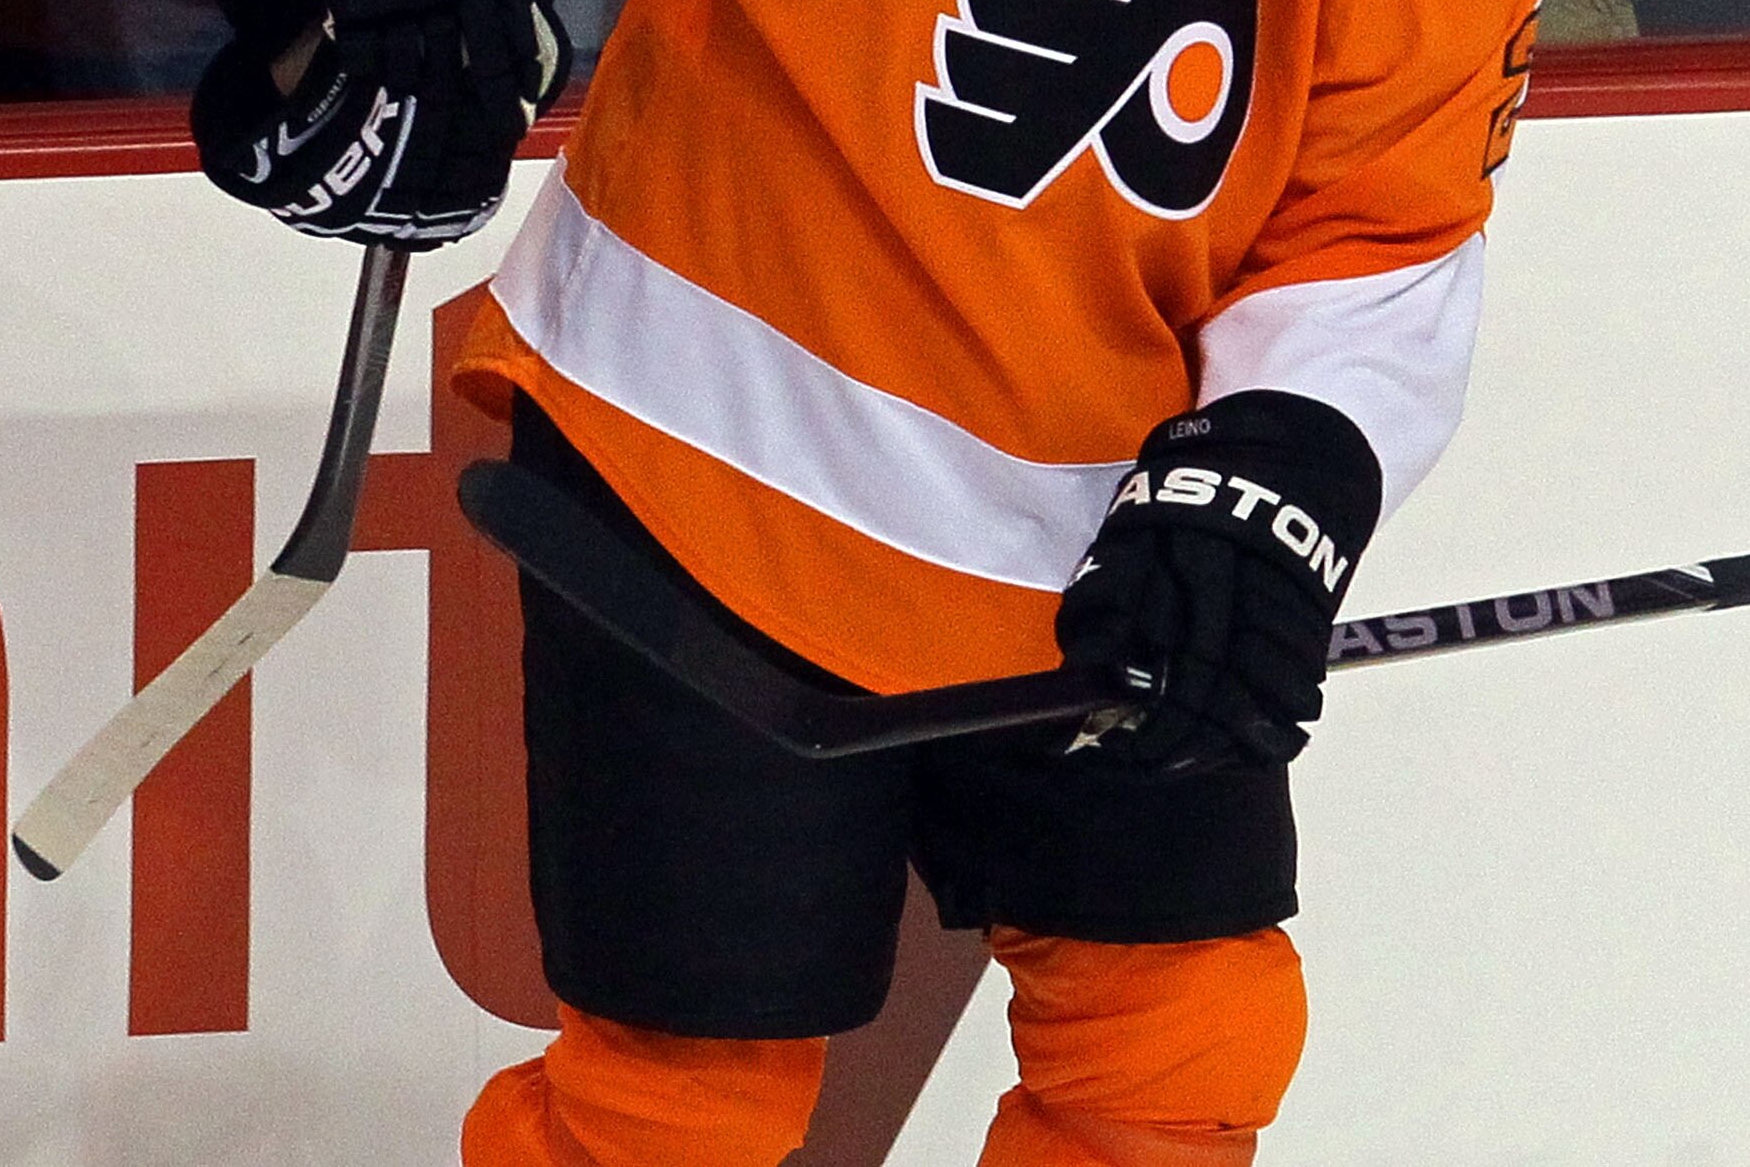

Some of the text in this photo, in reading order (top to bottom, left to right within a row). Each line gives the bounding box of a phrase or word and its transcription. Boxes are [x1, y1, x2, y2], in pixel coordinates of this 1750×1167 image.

[270, 86, 400, 218] UER
[1168, 418, 1211, 440] LEINO
[1108, 467, 1349, 593] ASTON
[1326, 580, 1615, 662] ASTON
